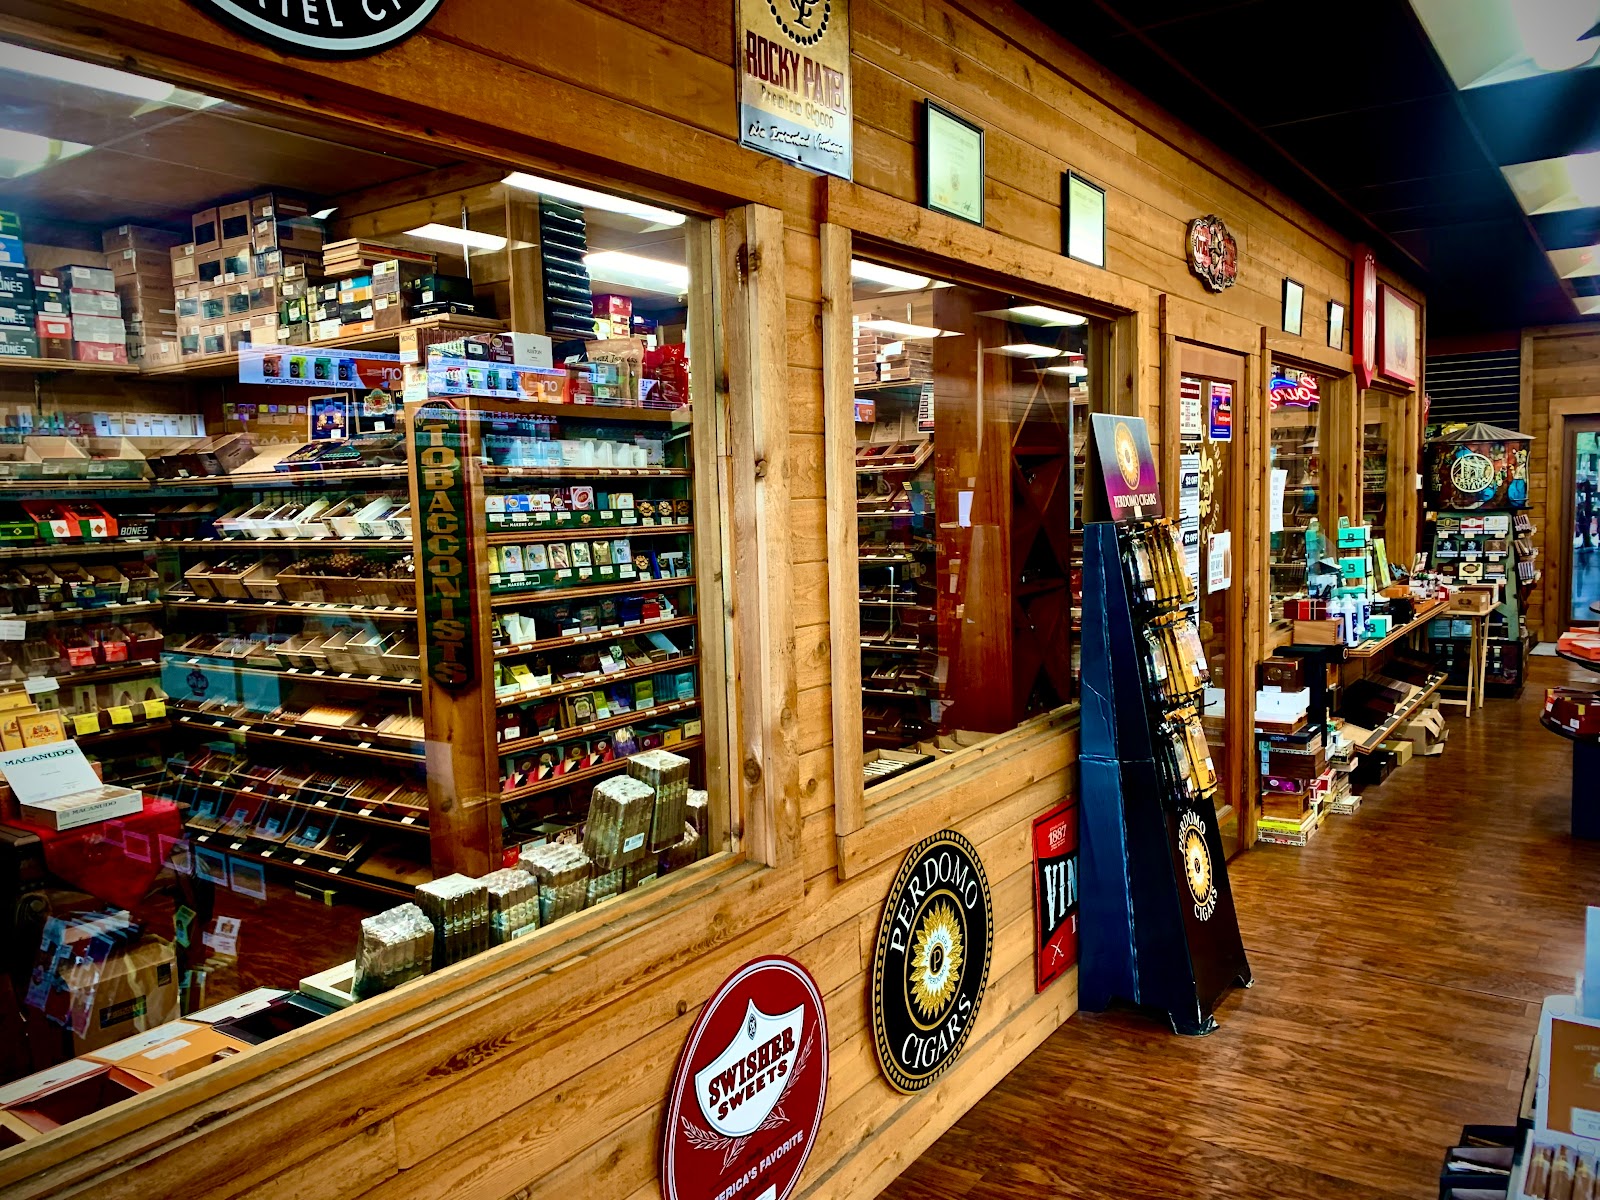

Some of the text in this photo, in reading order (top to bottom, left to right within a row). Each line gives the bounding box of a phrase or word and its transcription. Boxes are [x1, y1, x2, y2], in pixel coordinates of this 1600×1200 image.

[746, 29, 847, 115] ROCKY PATEL
[1113, 493, 1157, 508] PERDOMO CIGARS
[120, 526, 148, 535] BONES
[421, 423, 468, 683] TOBACCONISTS
[4, 748, 75, 767] MACANUDO
[72, 801, 117, 815] MACANUDO
[1178, 810, 1207, 854] PERDOMO
[1048, 824, 1067, 846] 1887
[890, 852, 979, 955] PERDOMO
[1194, 885, 1218, 921] CIGARS
[901, 993, 971, 1069] CIGARS
[708, 1026, 796, 1108] SWISHER
[717, 1059, 788, 1121] SWEETS
[715, 1130, 804, 1200] ERICA'S FAVORITE
